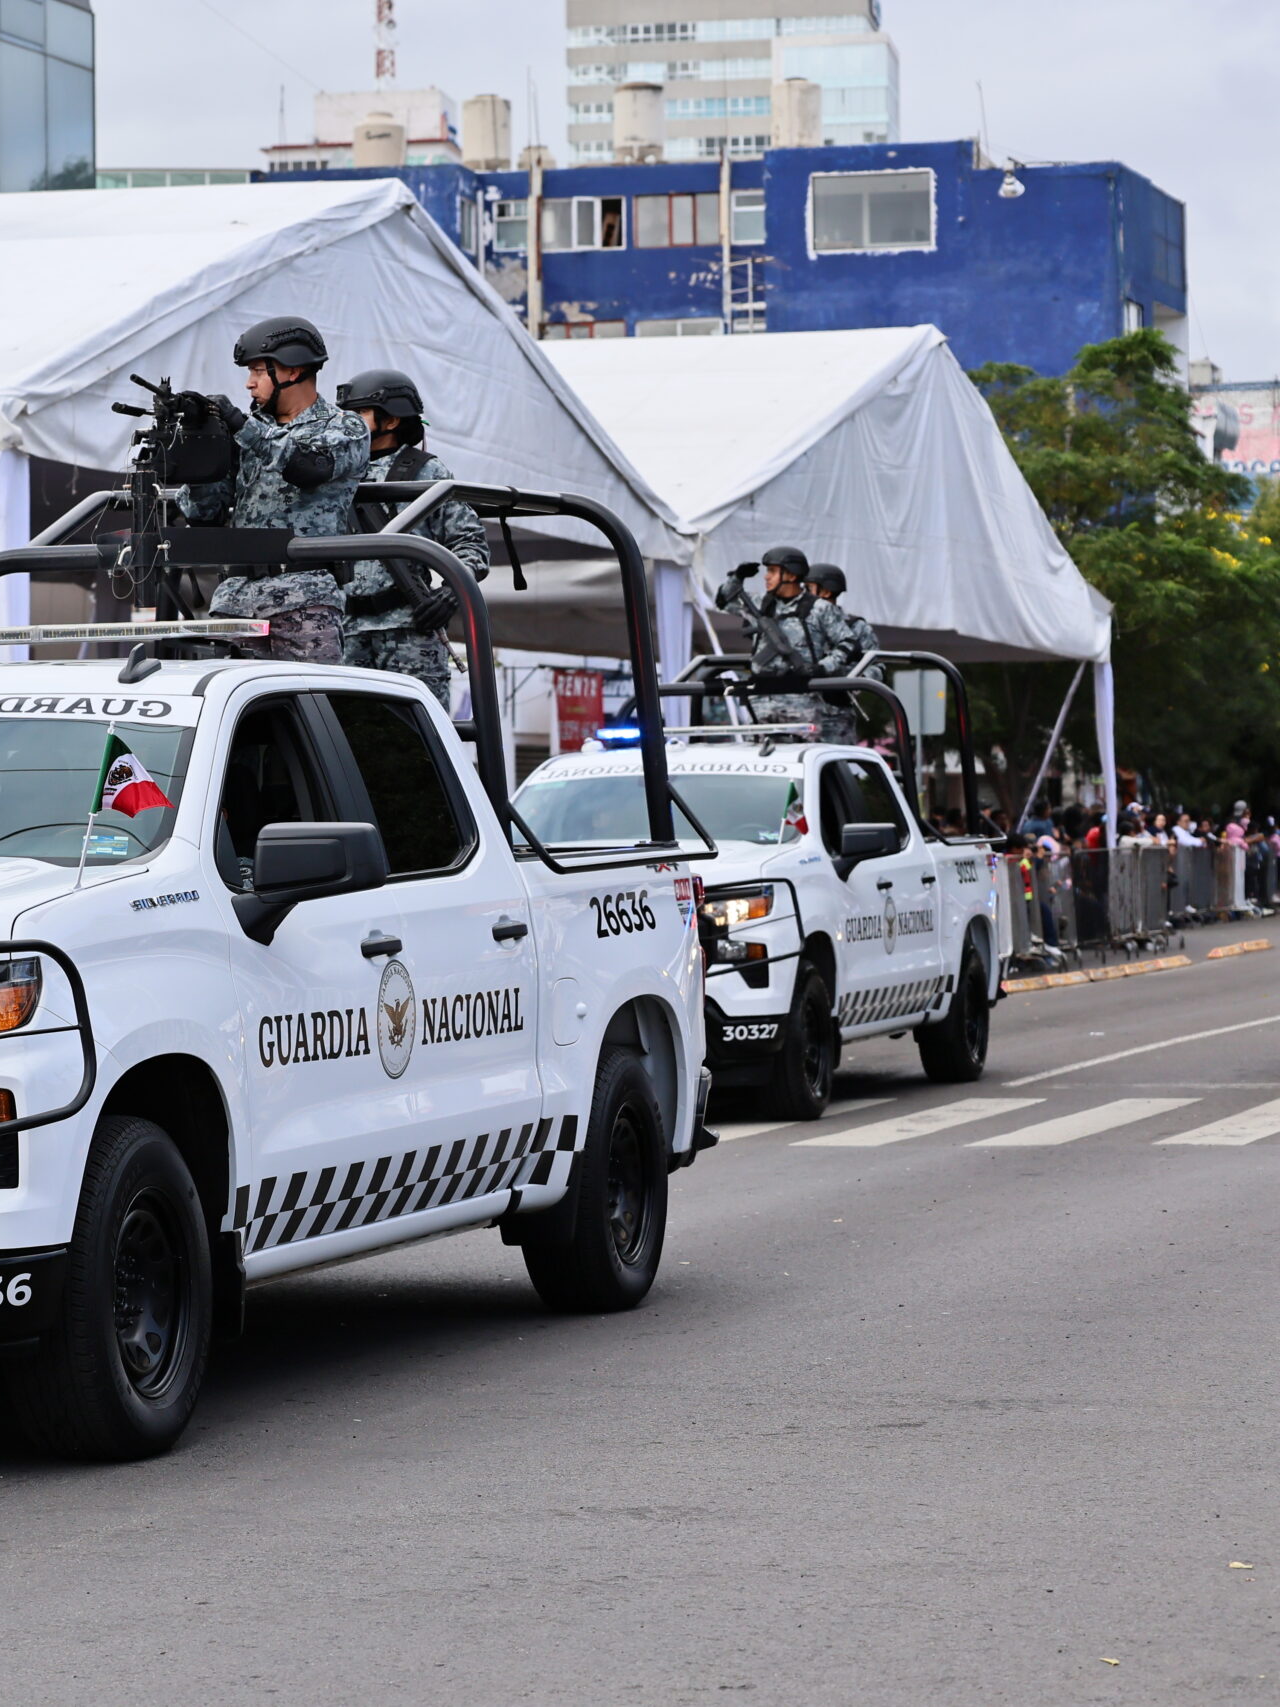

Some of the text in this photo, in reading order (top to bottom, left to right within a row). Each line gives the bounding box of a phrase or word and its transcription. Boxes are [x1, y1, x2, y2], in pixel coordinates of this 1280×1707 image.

[589, 889, 657, 939] 26636
[845, 909, 934, 942] GUARDIA NACIONAL
[258, 987, 524, 1068] GUARDIA NACIONAL
[722, 1023, 779, 1041] 30327
